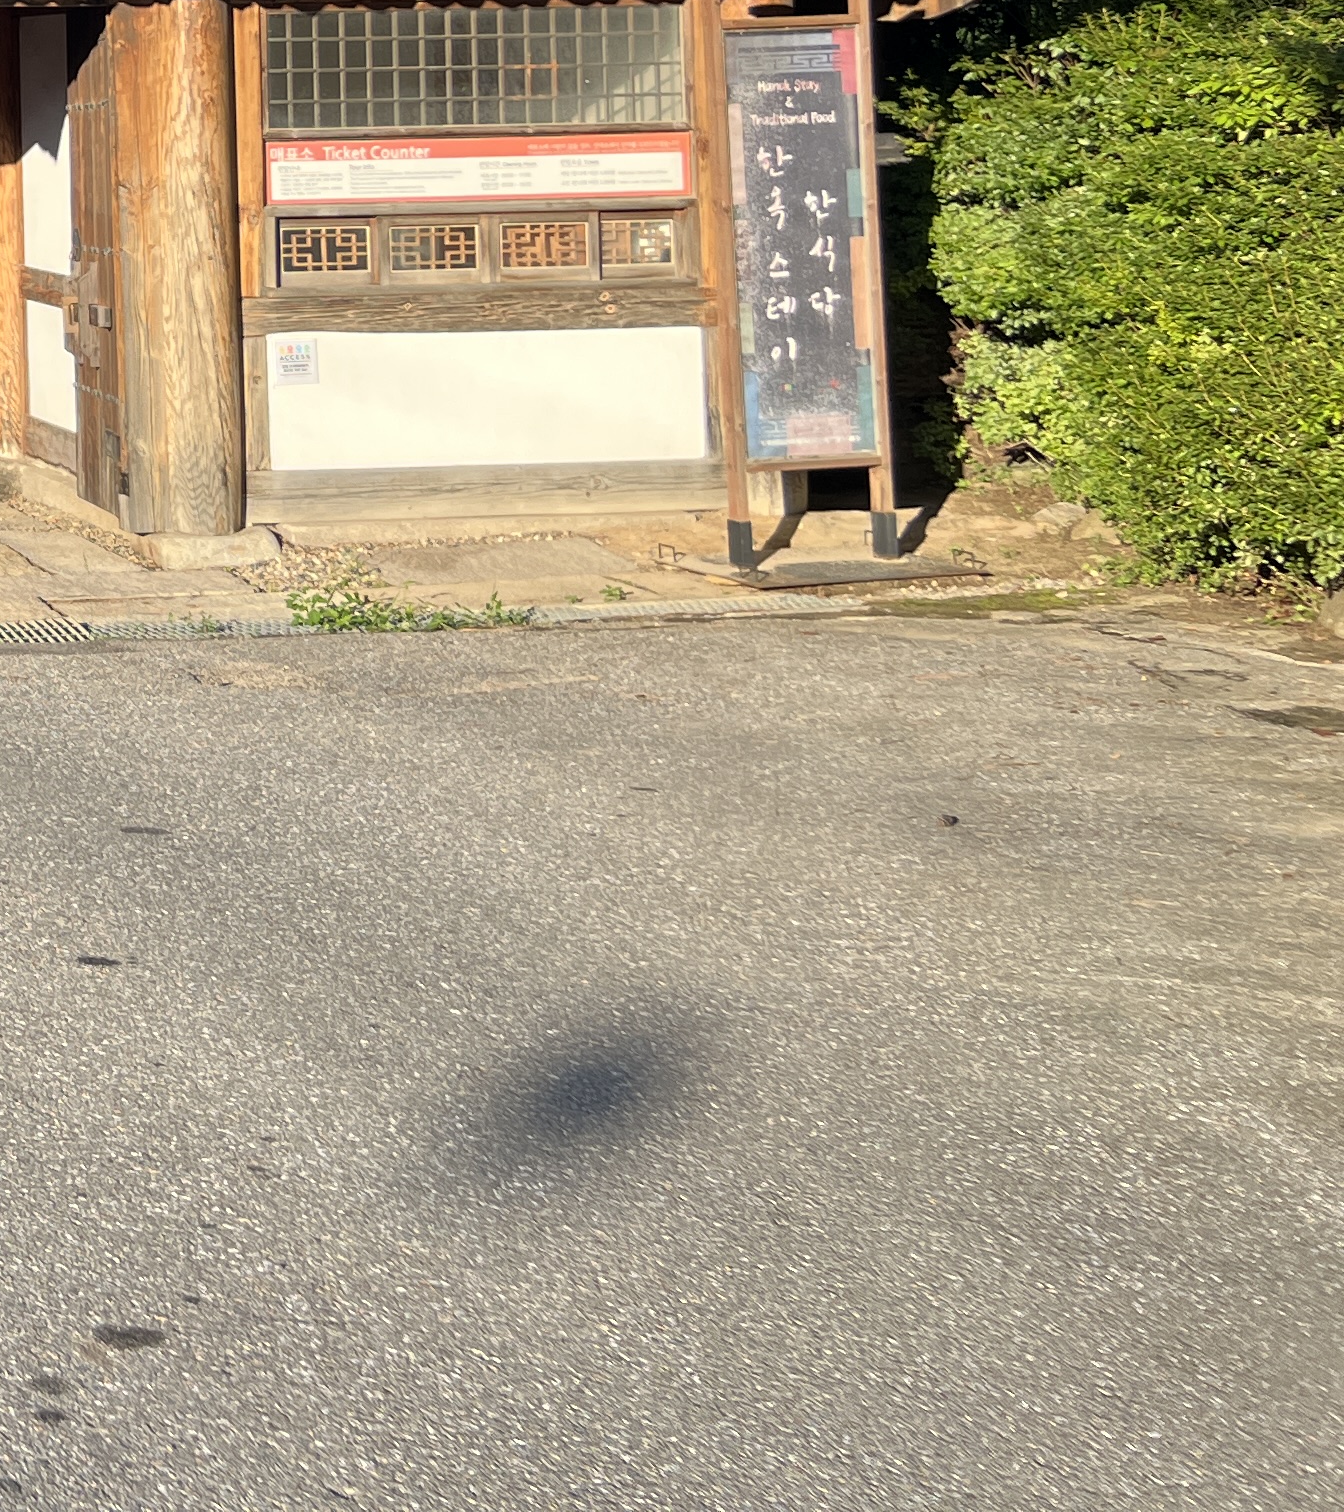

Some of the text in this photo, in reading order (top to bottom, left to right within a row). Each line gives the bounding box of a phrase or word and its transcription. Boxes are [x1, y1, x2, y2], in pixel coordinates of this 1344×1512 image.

[794, 79, 820, 93] Stay
[785, 96, 794, 108] &
[750, 110, 836, 126] Traditional Food
[270, 145, 431, 161] 매표소 Ticket Counter
[804, 189, 841, 315] 한식당
